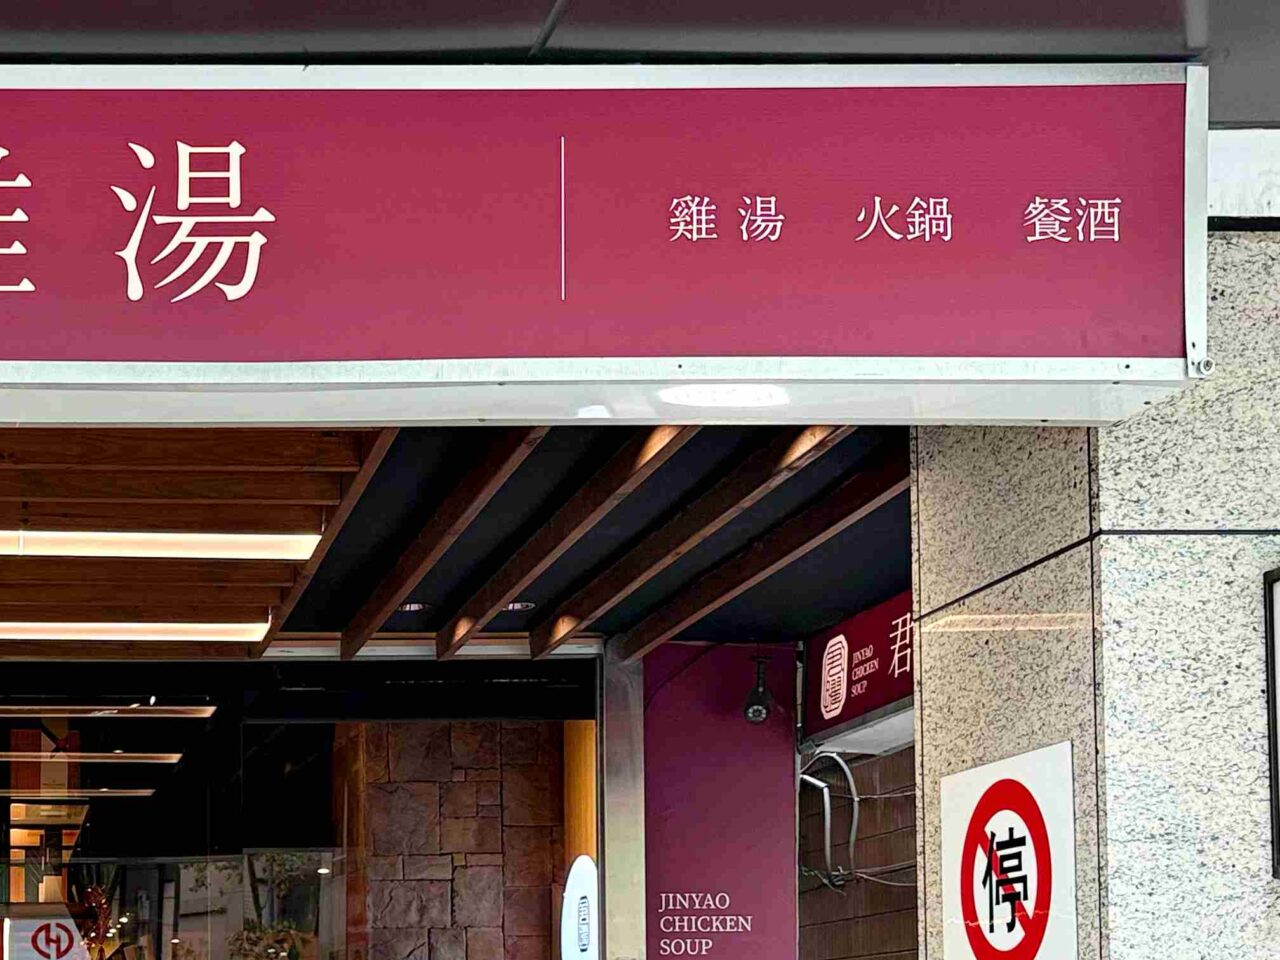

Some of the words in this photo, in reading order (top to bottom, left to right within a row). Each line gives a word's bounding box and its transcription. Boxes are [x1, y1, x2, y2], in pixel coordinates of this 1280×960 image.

[854, 195, 955, 243] 火鍋
[1022, 195, 1123, 243] 餐酒
[981, 826, 1030, 935] 停
[659, 892, 730, 913] JINYAO
[659, 915, 753, 933] CHICKEN
[659, 938, 714, 956] SOUP
